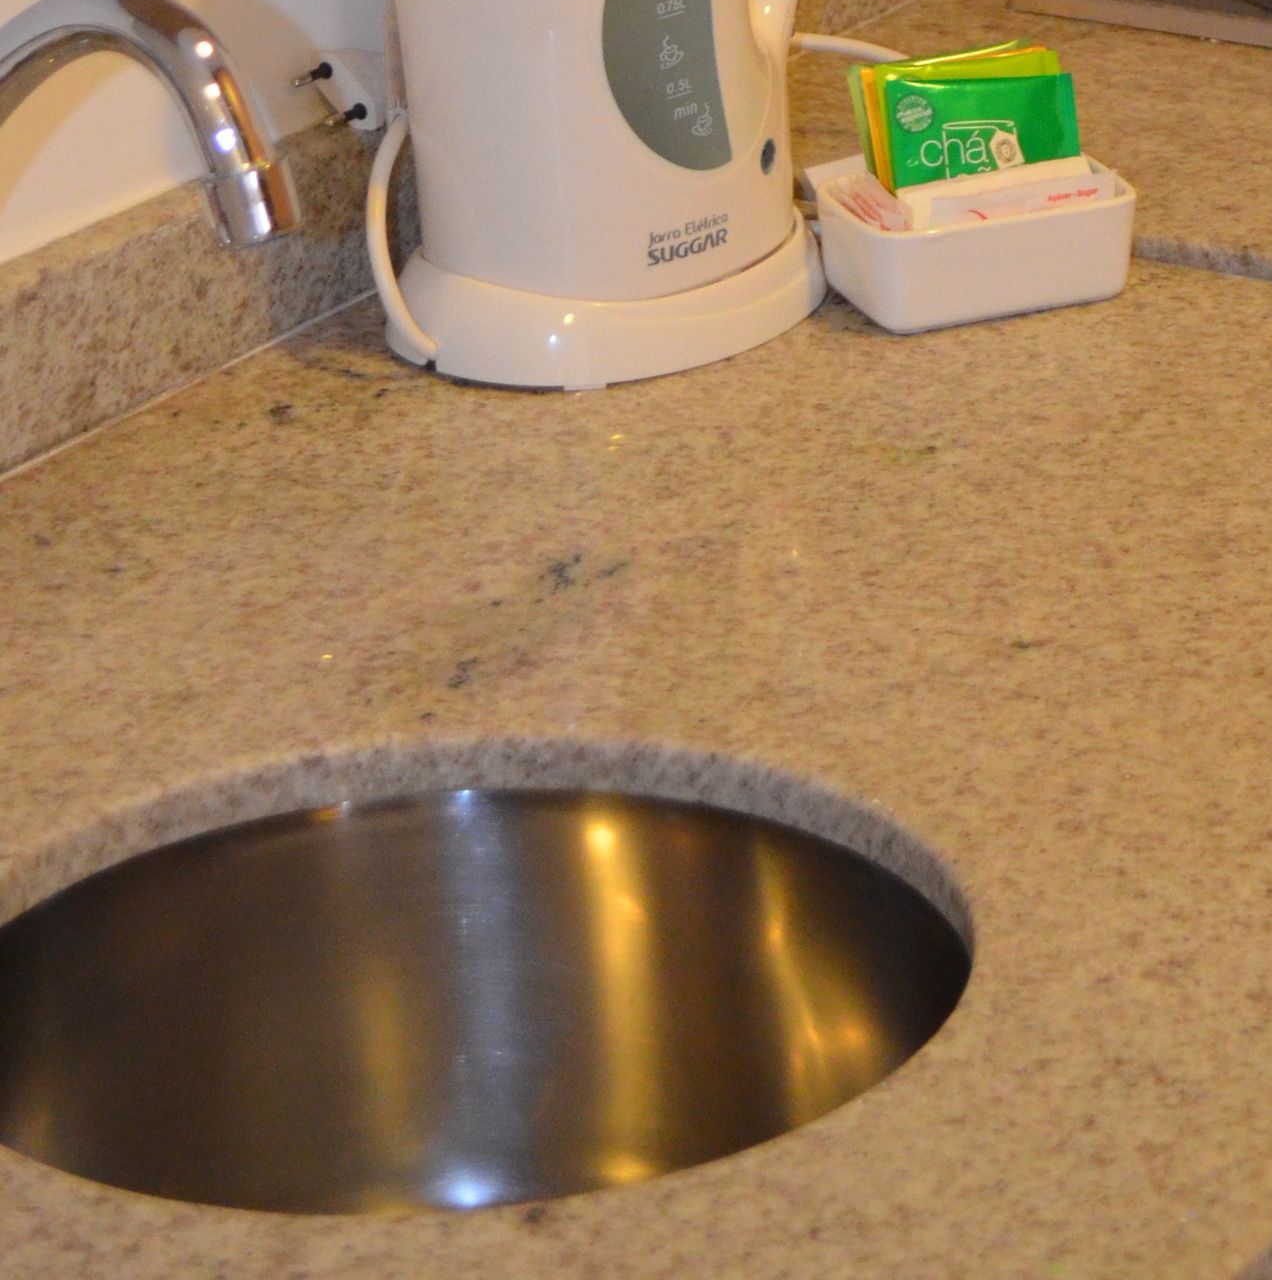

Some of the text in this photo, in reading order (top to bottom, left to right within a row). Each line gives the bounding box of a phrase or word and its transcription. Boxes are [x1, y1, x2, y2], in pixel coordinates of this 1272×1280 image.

[666, 78, 692, 95] 0.5L
[673, 102, 698, 121] min
[920, 129, 990, 168] chá
[647, 227, 728, 267] SUGGAR
